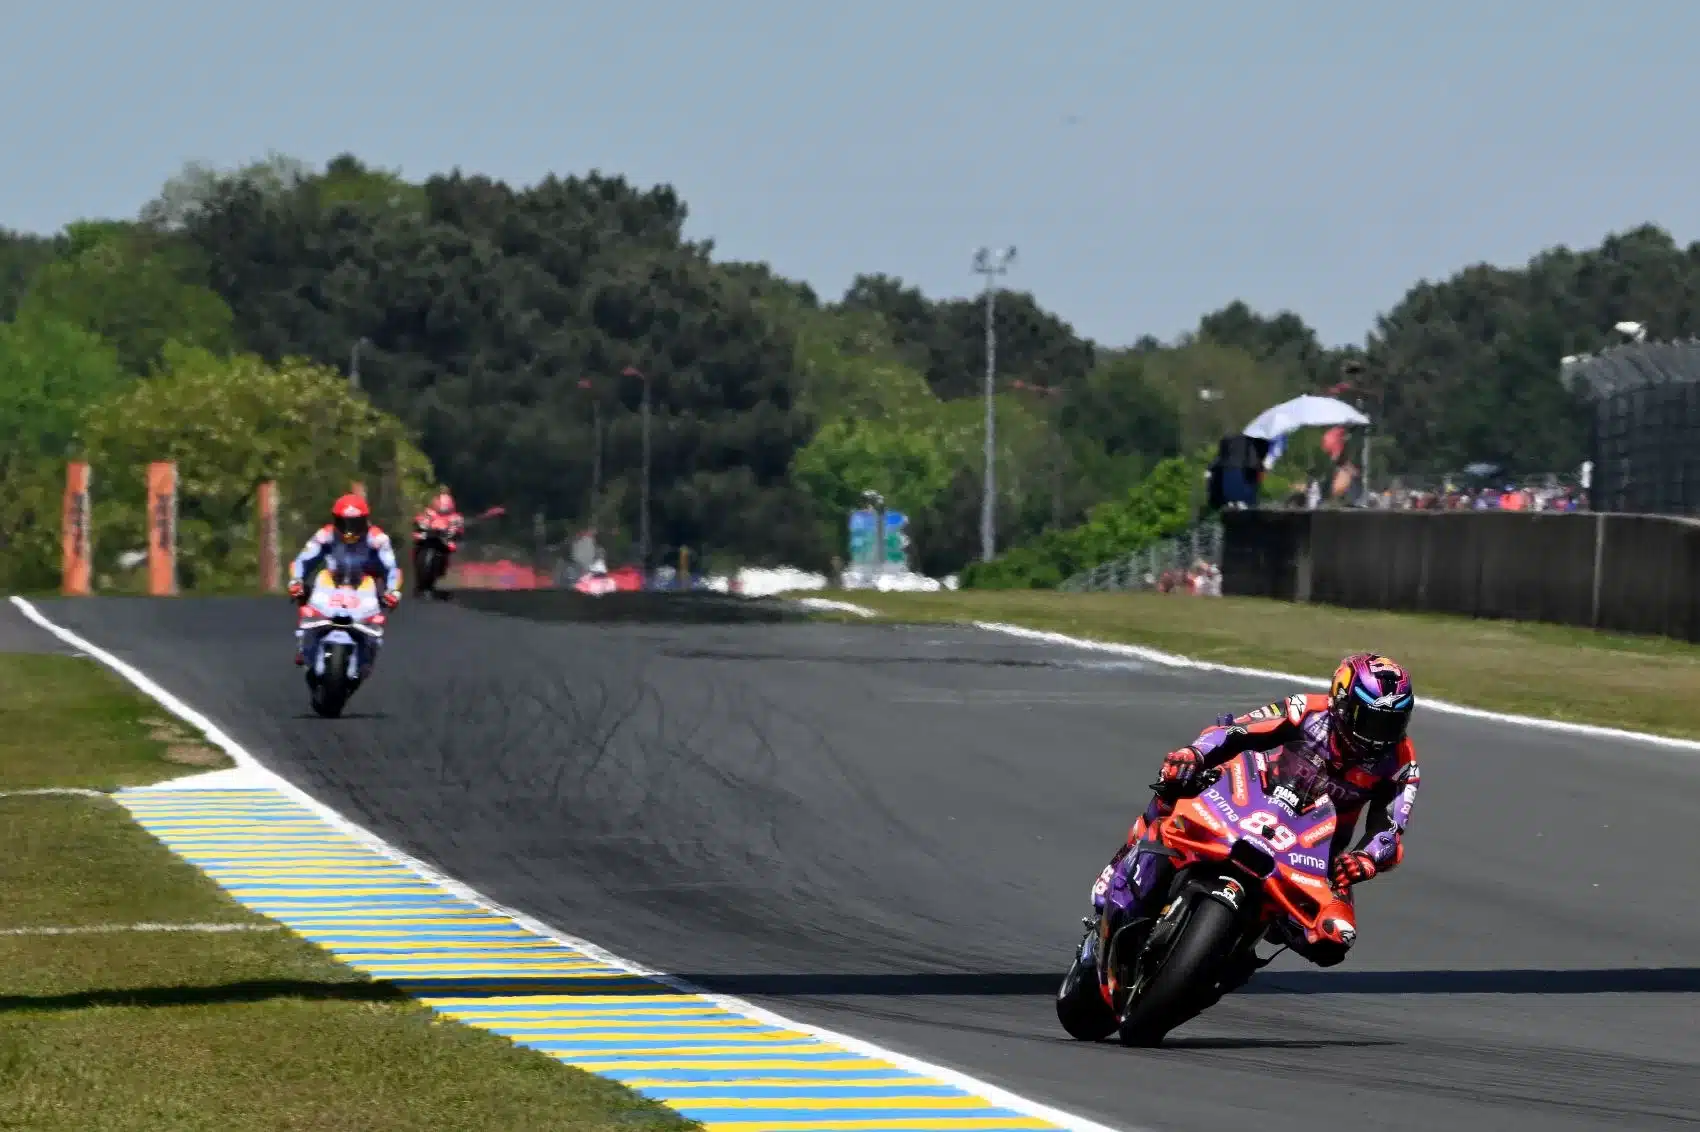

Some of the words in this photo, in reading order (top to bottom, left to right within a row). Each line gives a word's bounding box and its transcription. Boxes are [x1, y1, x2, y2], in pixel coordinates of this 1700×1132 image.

[1204, 788, 1239, 822] prima
[1268, 797, 1294, 817] prima
[1273, 786, 1300, 807] FIAMM
[1239, 811, 1297, 852] 89
[1243, 834, 1275, 857] PRAMAC
[1288, 853, 1326, 870] prima
